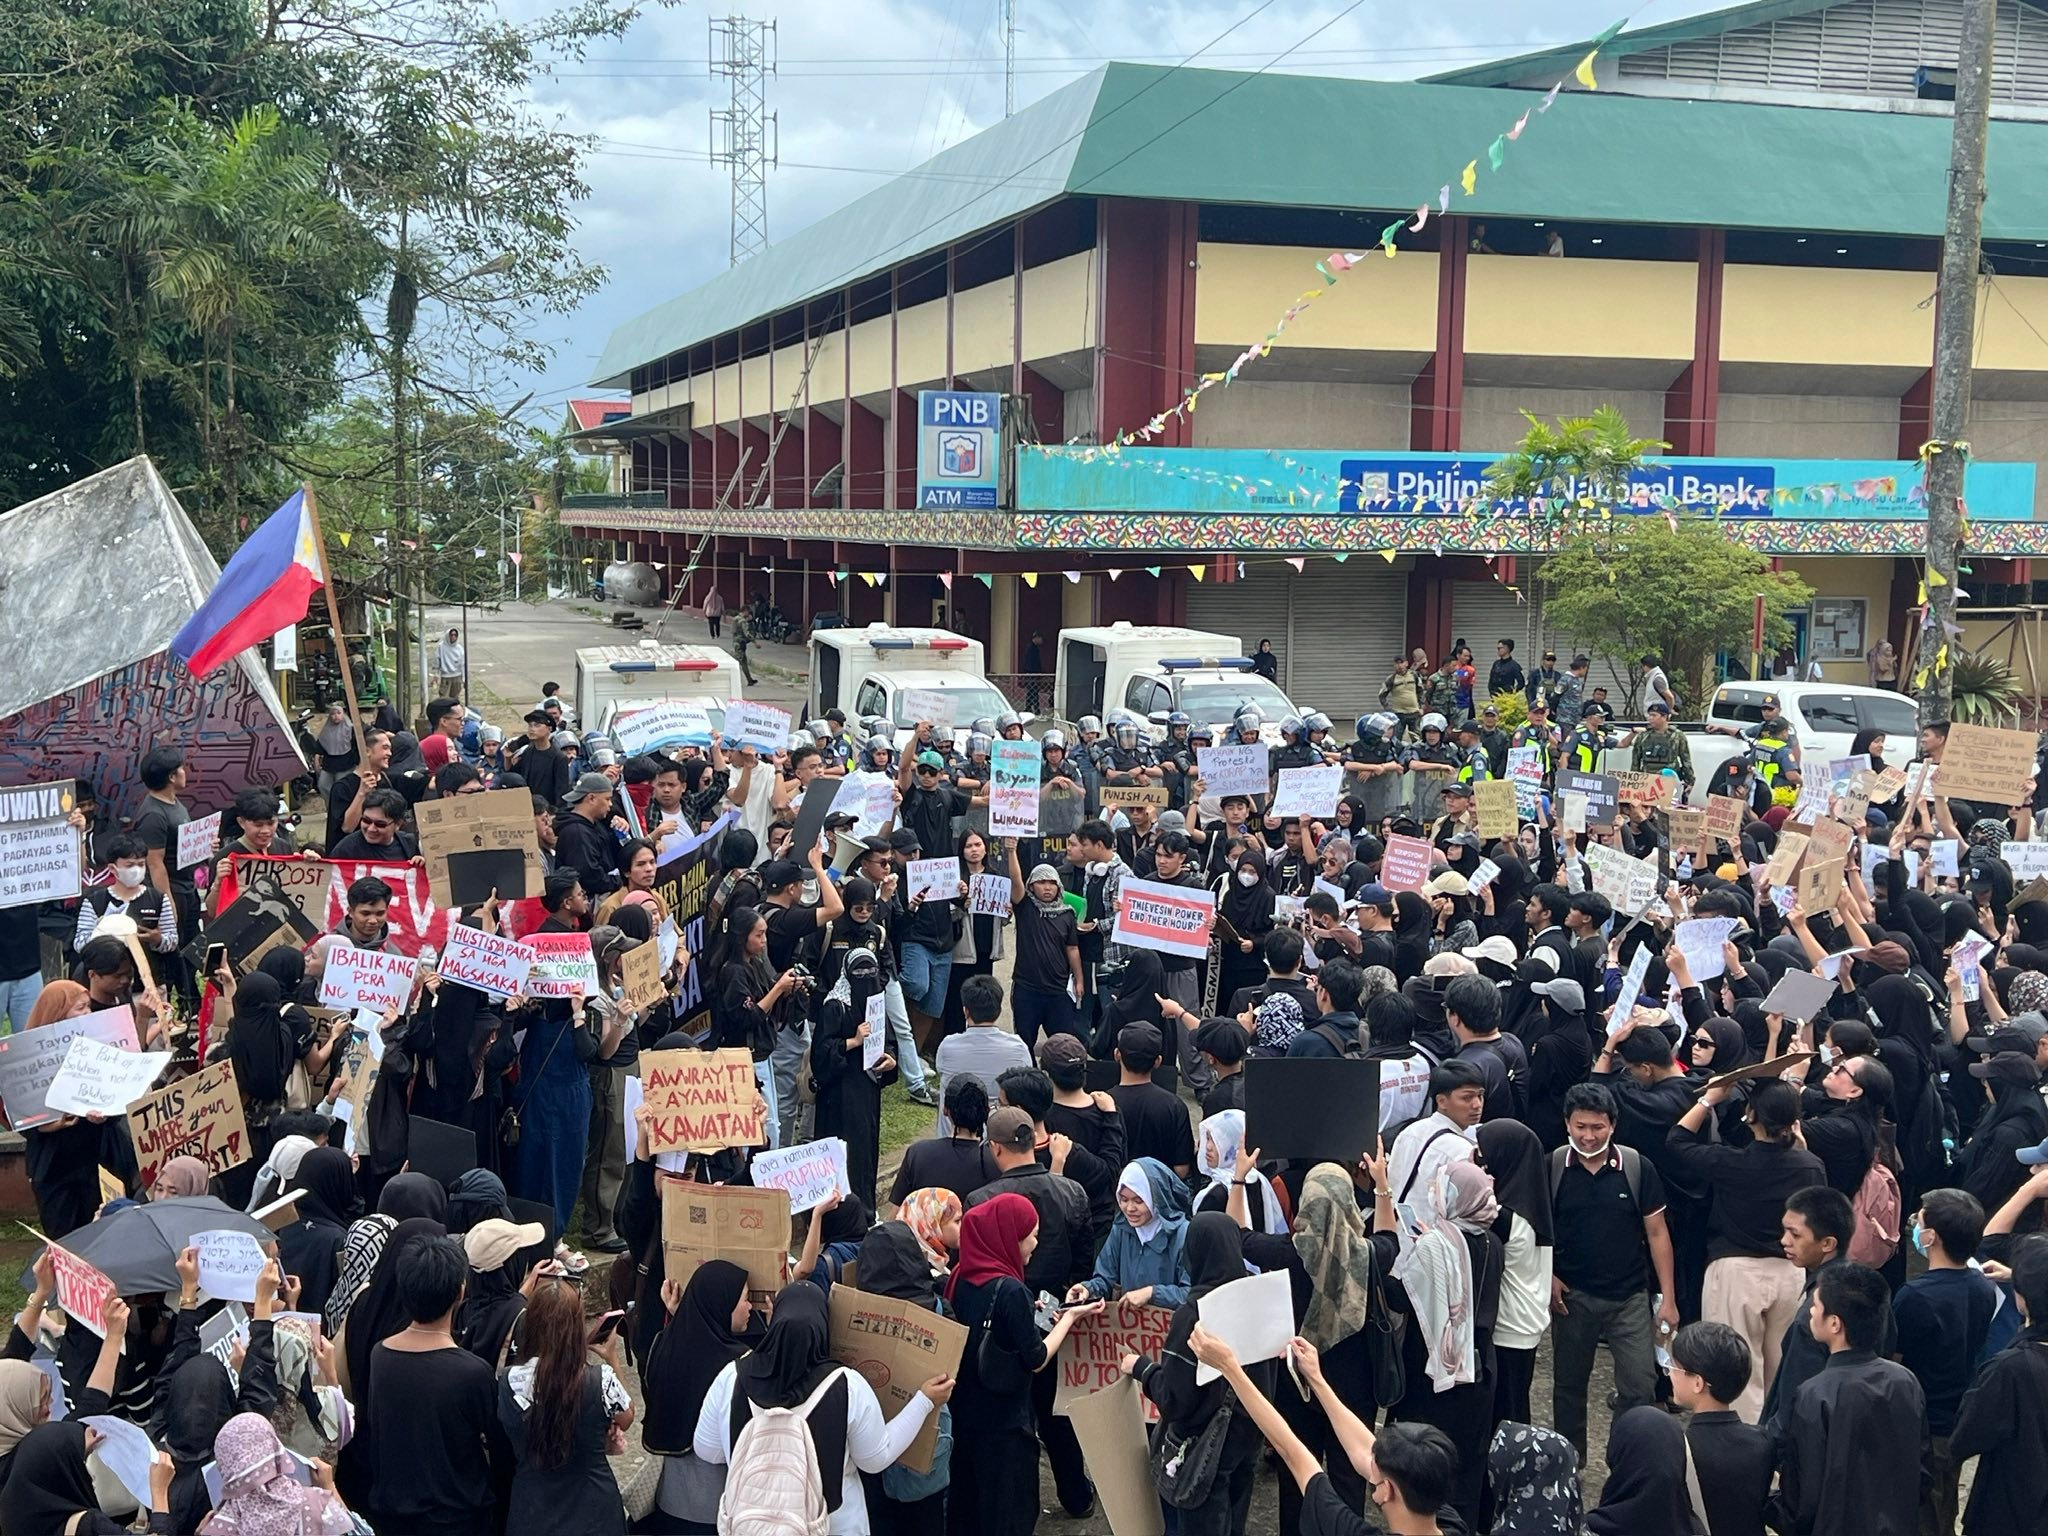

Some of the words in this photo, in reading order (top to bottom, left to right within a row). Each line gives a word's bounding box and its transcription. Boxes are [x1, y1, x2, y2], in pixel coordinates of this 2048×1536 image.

[934, 398, 988, 424] PNB
[925, 489, 961, 505] ATM
[1398, 472, 1543, 511] Philip
[1682, 476, 1754, 505] Bank
[1425, 771, 1445, 780] PULI
[1104, 789, 1140, 801] PUNISH
[1143, 794, 1161, 803] ALL
[10, 826, 69, 842] PAGTAHIMIK
[1043, 838, 1070, 852] PULI
[4, 846, 52, 862] PAGPAYAG
[56, 843, 69, 853] SA
[4, 887, 17, 896] SA
[21, 880, 51, 892] BAYAN
[1130, 911, 1144, 922] END
[1148, 914, 1168, 927] THER
[331, 948, 383, 969] IBALIK
[387, 959, 415, 979] ANG
[460, 948, 475, 960] SA
[483, 954, 507, 969] MGA
[440, 956, 518, 993] MAGSASAKA
[556, 964, 595, 978] CORRUPT
[325, 984, 348, 999] NG
[357, 990, 401, 1008] BAYAN
[132, 1090, 185, 1131] THIS
[191, 1073, 223, 1098] is
[138, 1115, 186, 1154] WHERE
[188, 1098, 234, 1132] your
[652, 1113, 757, 1147] KAWATAN
[759, 1159, 780, 1175] over
[784, 1145, 816, 1165] naman
[818, 1142, 830, 1153] sa
[857, 1310, 891, 1321] HANDLE
[892, 1316, 912, 1327] WITH
[914, 1324, 936, 1337] CARE
[1064, 1361, 1089, 1388] NO
[1094, 1363, 1121, 1388] TO
